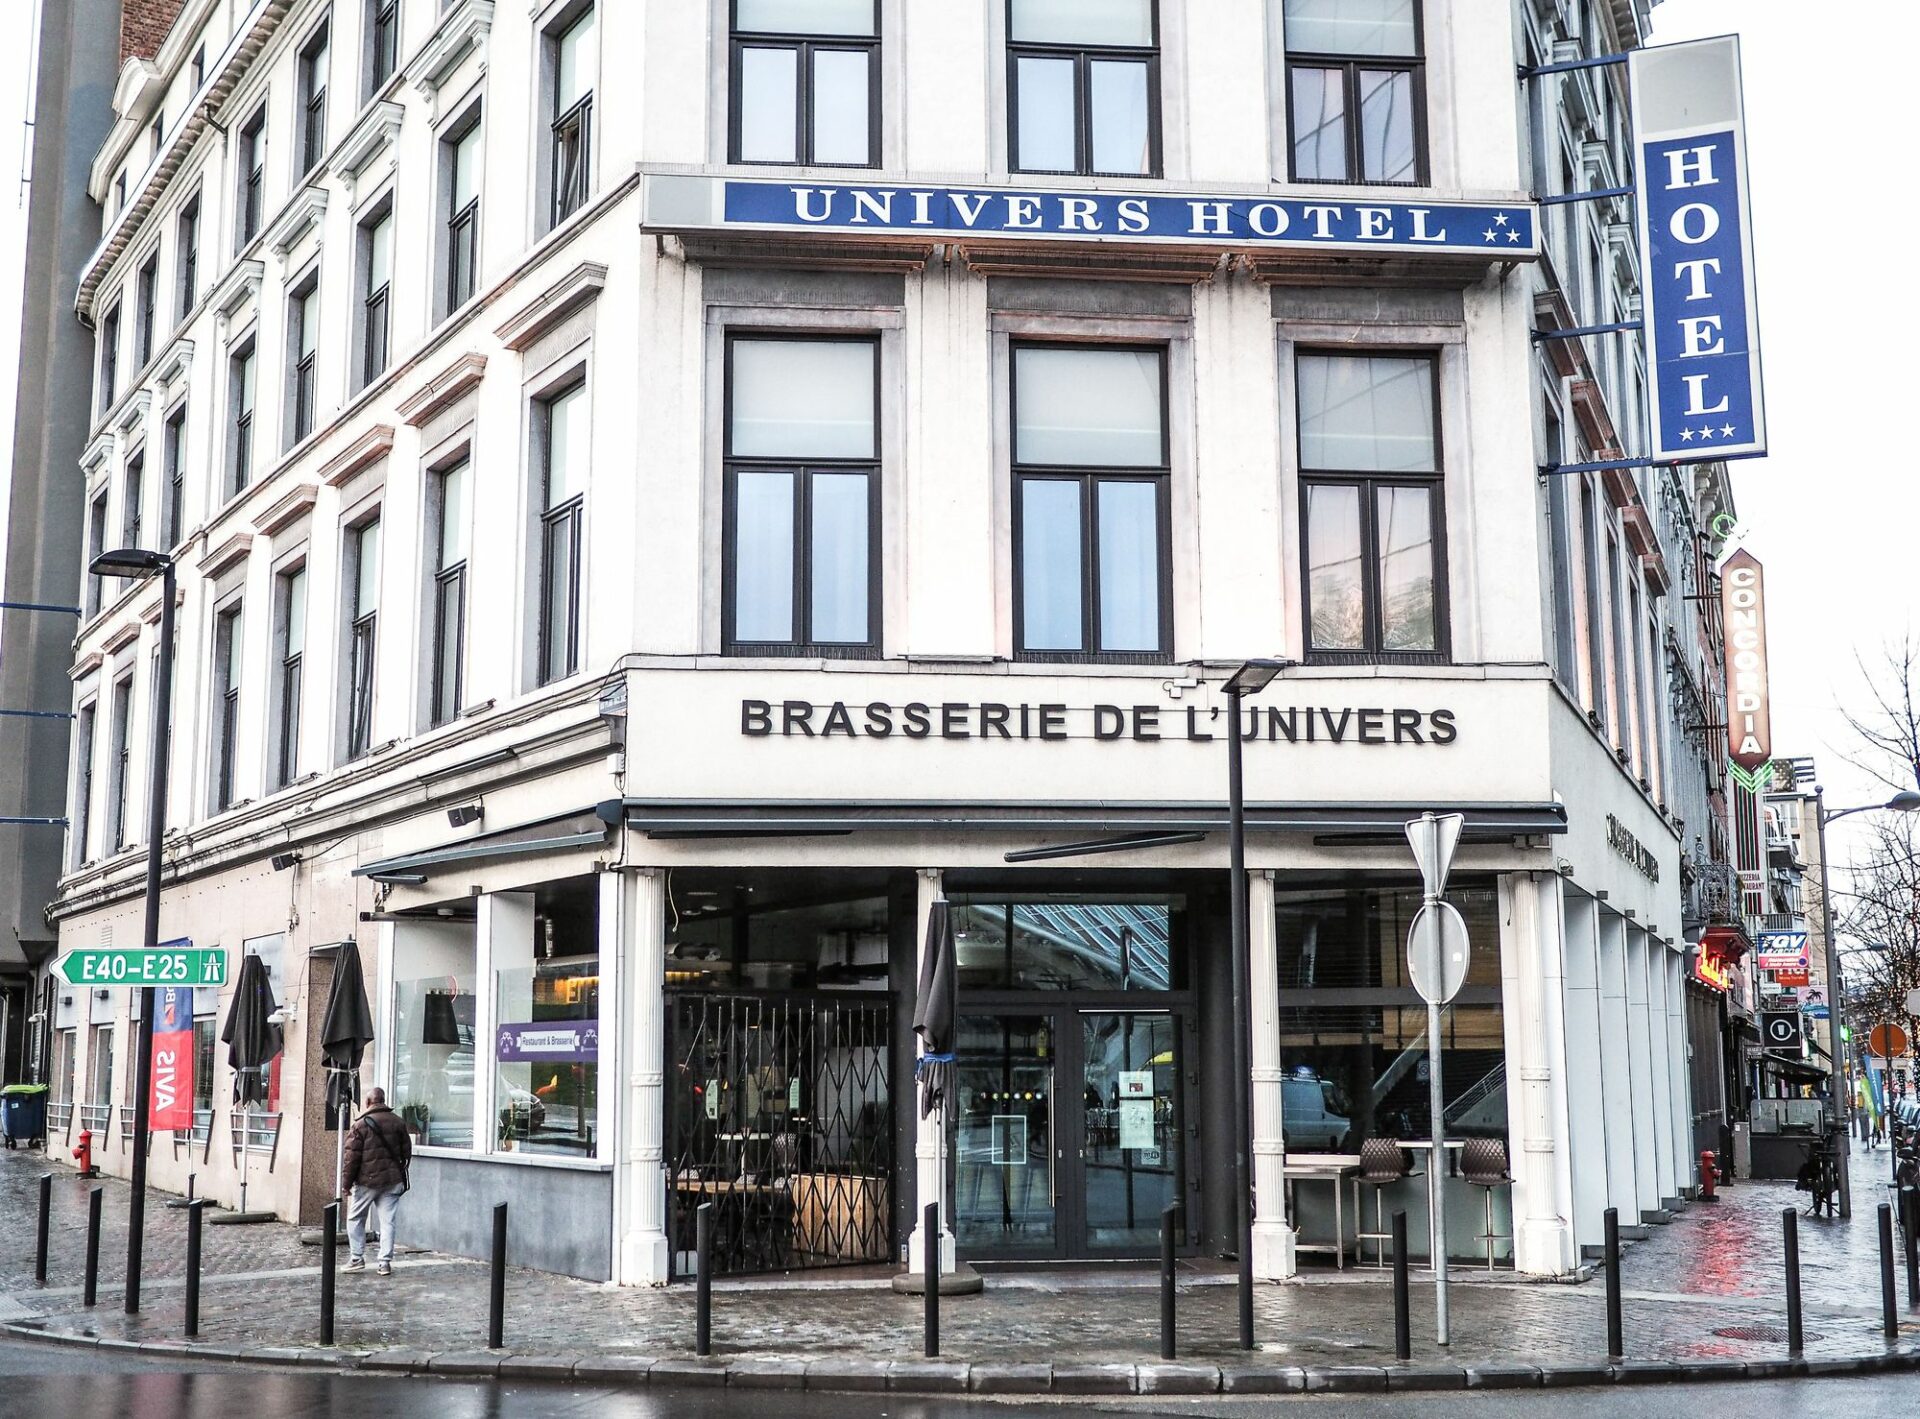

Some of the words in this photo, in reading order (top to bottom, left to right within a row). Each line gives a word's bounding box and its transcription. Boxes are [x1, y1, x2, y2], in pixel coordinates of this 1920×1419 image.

[790, 185, 1150, 232] UNIVERS
[1187, 202, 1447, 242] HOTEL
[1663, 145, 1729, 416] HOTEL
[742, 699, 1067, 740] BRASSERIE
[1094, 704, 1160, 740] DE
[1187, 705, 1458, 744] L'UNIVERS
[1729, 567, 1763, 755] CONCORDIA
